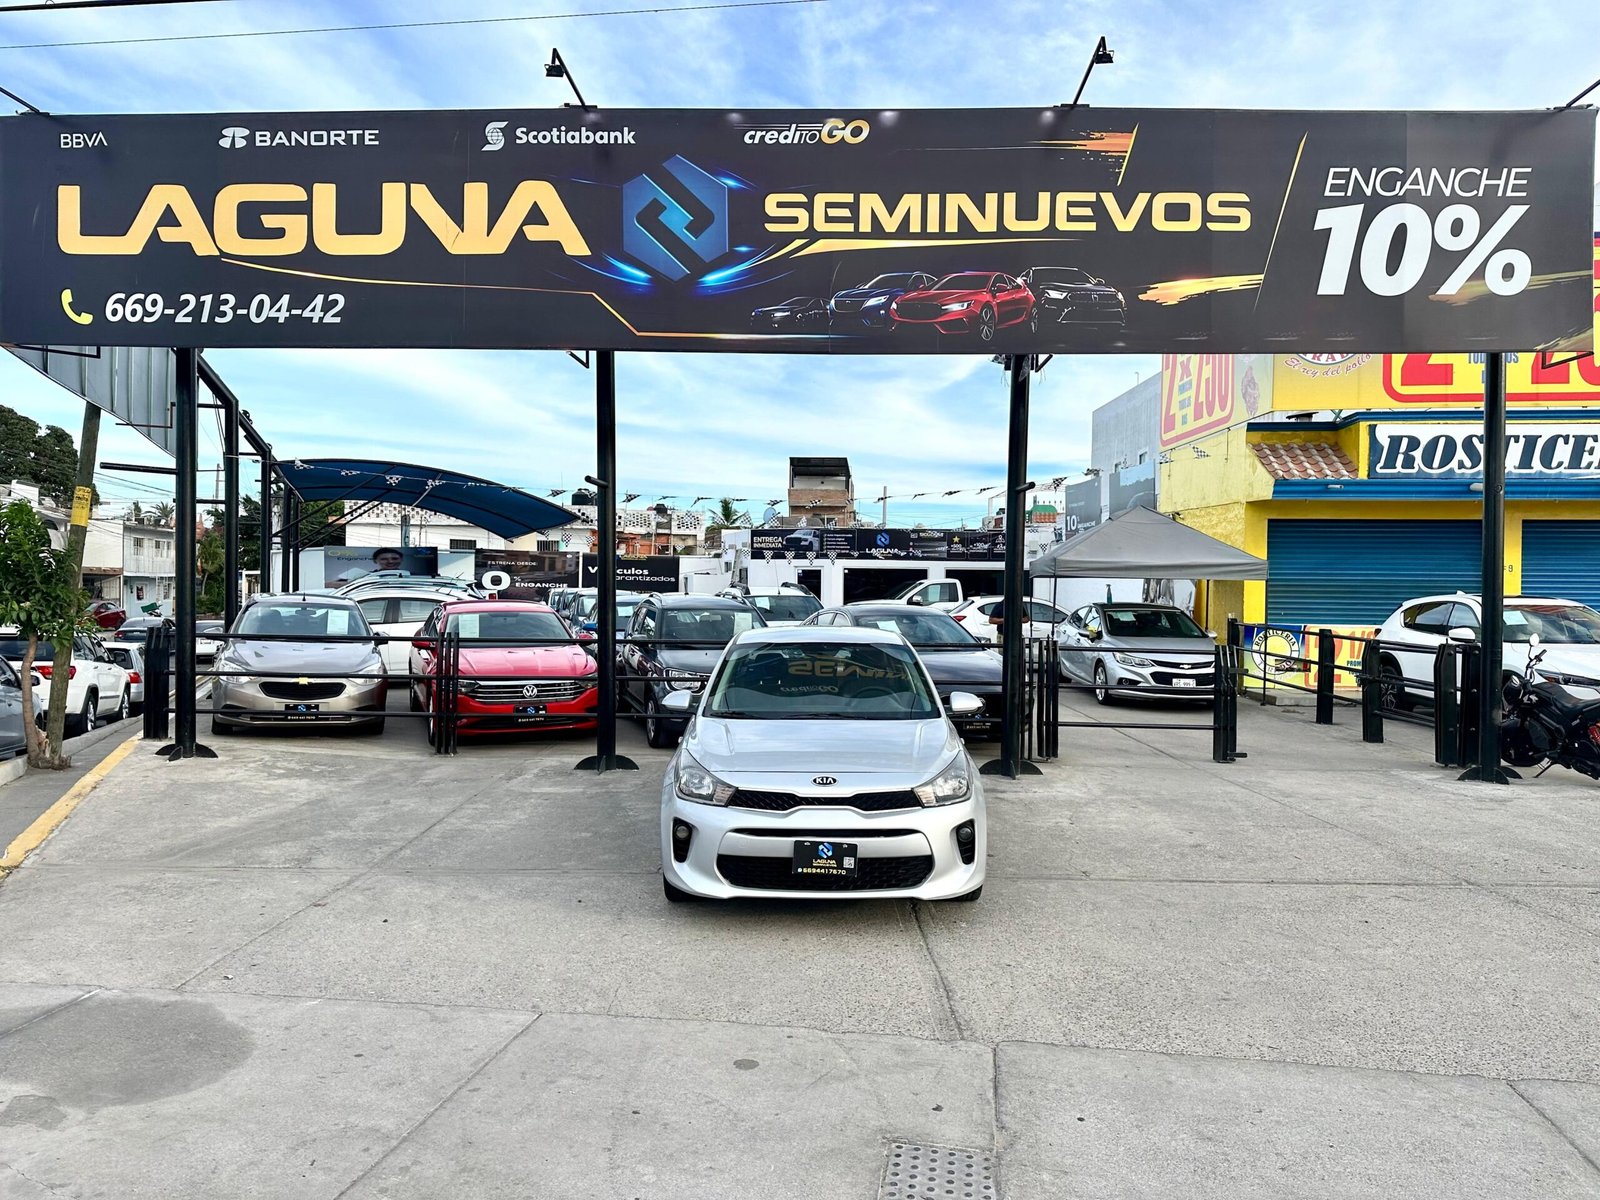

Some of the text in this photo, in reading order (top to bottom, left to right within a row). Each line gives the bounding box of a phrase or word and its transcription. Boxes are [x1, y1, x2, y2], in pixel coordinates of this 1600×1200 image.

[60, 131, 108, 148] BBVA
[255, 129, 380, 147] BANORTE
[515, 125, 636, 145] Scotiabank
[1323, 167, 1533, 198] ENGANCHE
[57, 180, 592, 257] LAGUNA
[764, 191, 1252, 233] SEMINUEVOS
[1313, 202, 1533, 297] 10%
[104, 292, 346, 324] 669-213-04-42
[1302, 367, 1319, 378] rey
[1322, 366, 1341, 376] del
[482, 571, 511, 591] 0
